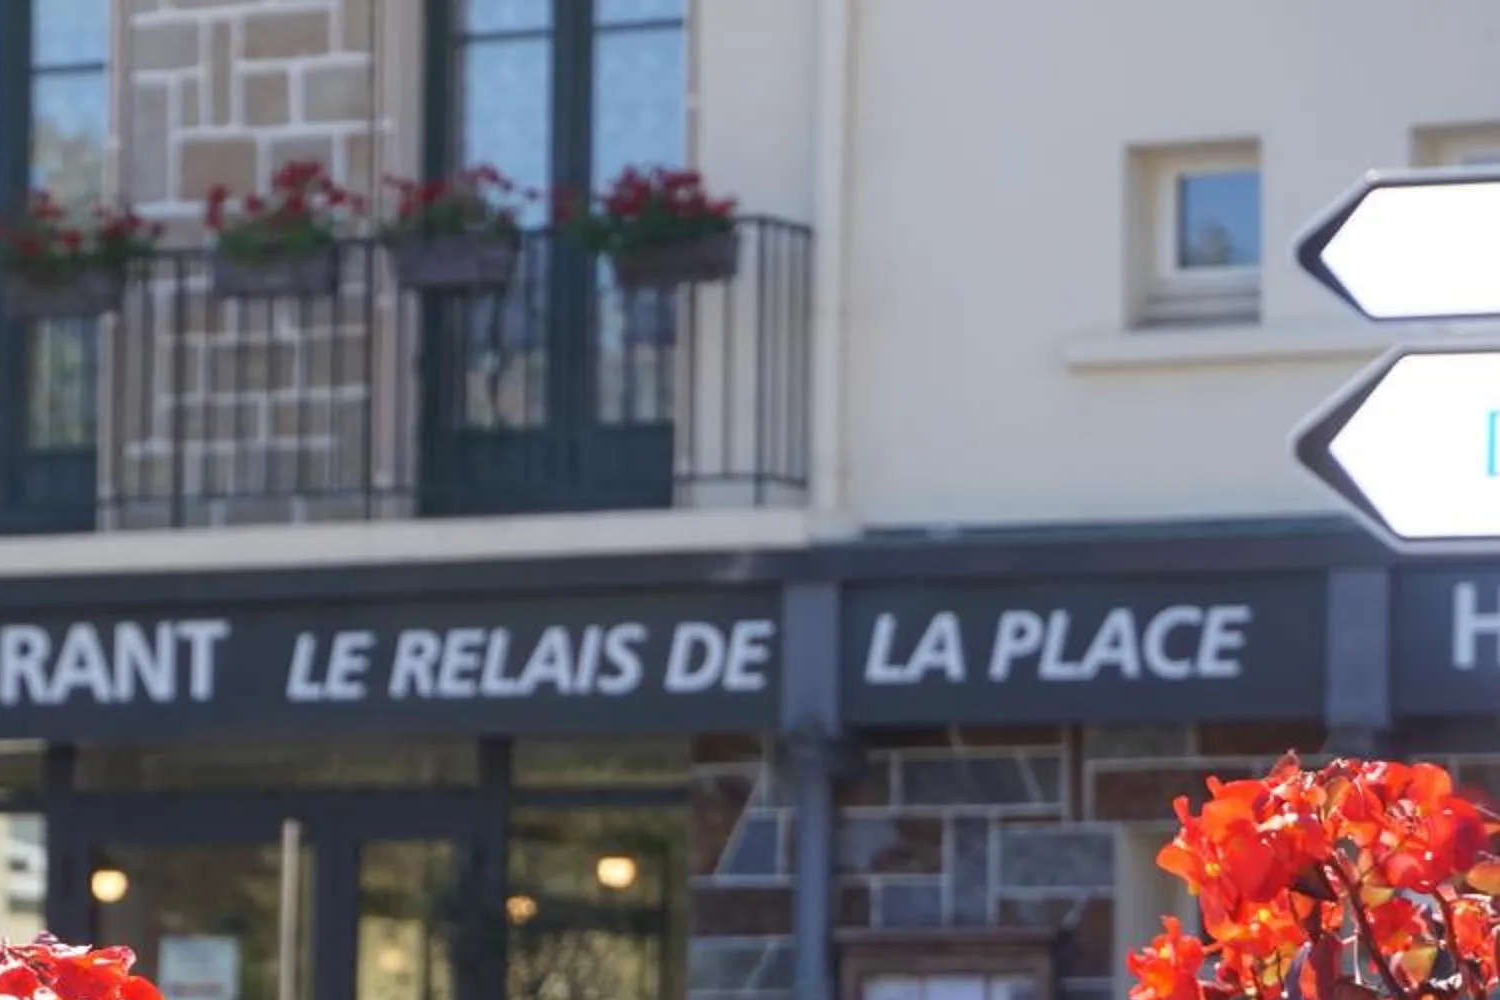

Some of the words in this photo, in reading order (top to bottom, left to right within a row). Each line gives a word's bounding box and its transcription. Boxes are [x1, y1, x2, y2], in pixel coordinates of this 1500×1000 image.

[286, 631, 373, 699] LE
[388, 623, 645, 697] RELAIS
[664, 619, 773, 691] DE
[865, 612, 964, 682] LA
[988, 605, 1250, 679] PLACE
